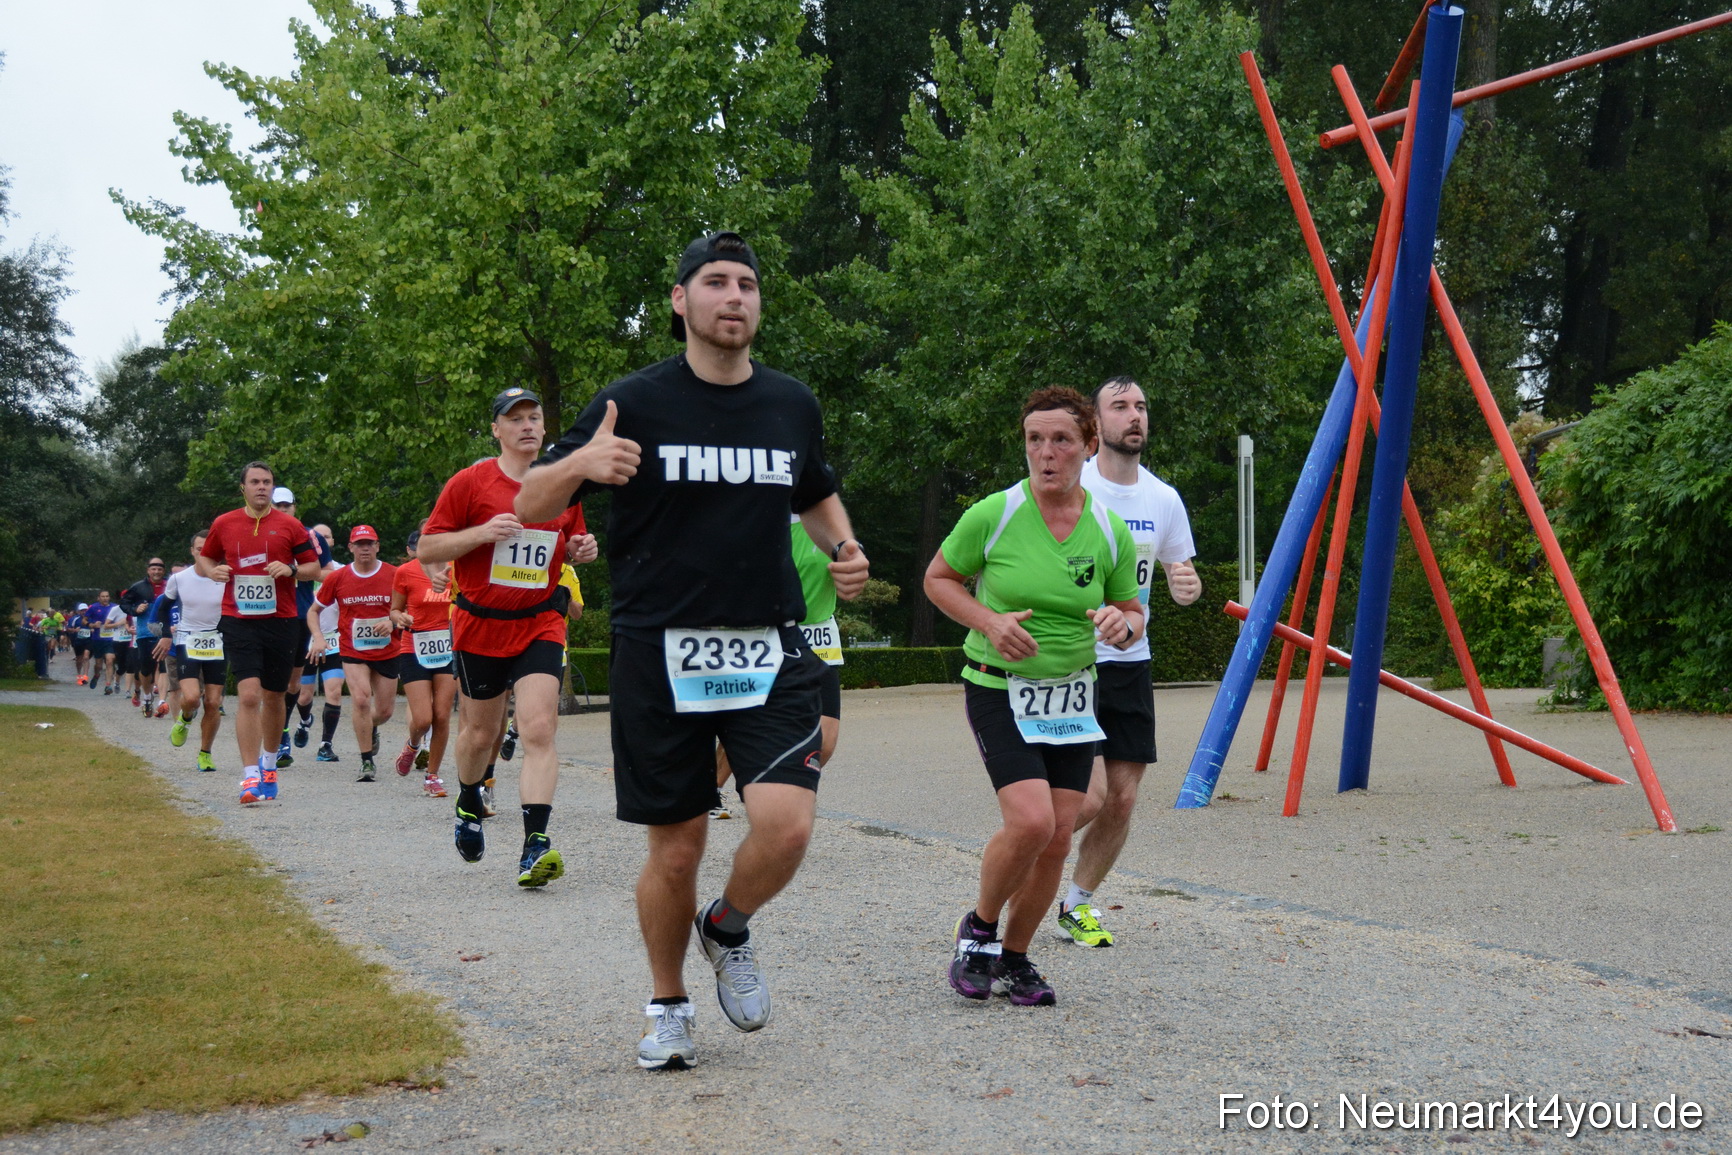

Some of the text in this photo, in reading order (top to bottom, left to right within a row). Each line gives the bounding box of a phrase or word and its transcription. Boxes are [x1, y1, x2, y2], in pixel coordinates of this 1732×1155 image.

[659, 445, 793, 486] THULE
[760, 474, 790, 482] SWEDEN
[1124, 519, 1155, 532] MA
[509, 542, 547, 567] 116
[511, 570, 537, 581] Alfred
[238, 585, 273, 600] 2623
[343, 595, 383, 604] NEUMARKT
[194, 638, 216, 650] 238
[419, 638, 452, 655] 2802
[679, 637, 775, 671] 2332
[704, 678, 757, 696] Patrick
[1019, 681, 1087, 716] 2773
[1036, 723, 1084, 736] Christine
